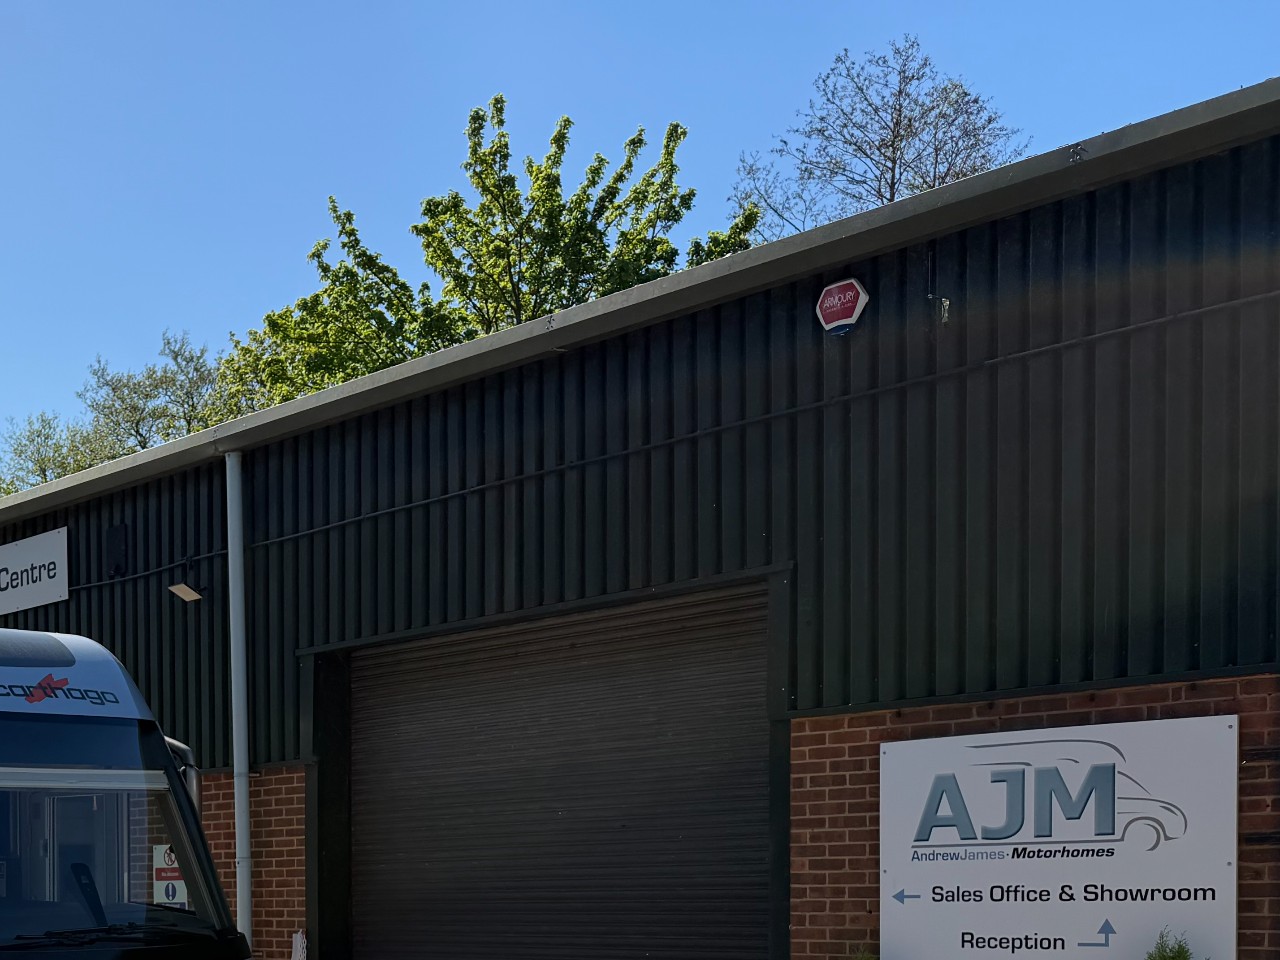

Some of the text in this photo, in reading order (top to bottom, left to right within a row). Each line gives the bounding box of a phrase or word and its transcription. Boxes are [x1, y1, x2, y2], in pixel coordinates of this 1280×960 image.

[913, 762, 1116, 843] AJM
[931, 883, 1217, 903] Sales Office & Showroom
[960, 932, 1066, 953] Reception
